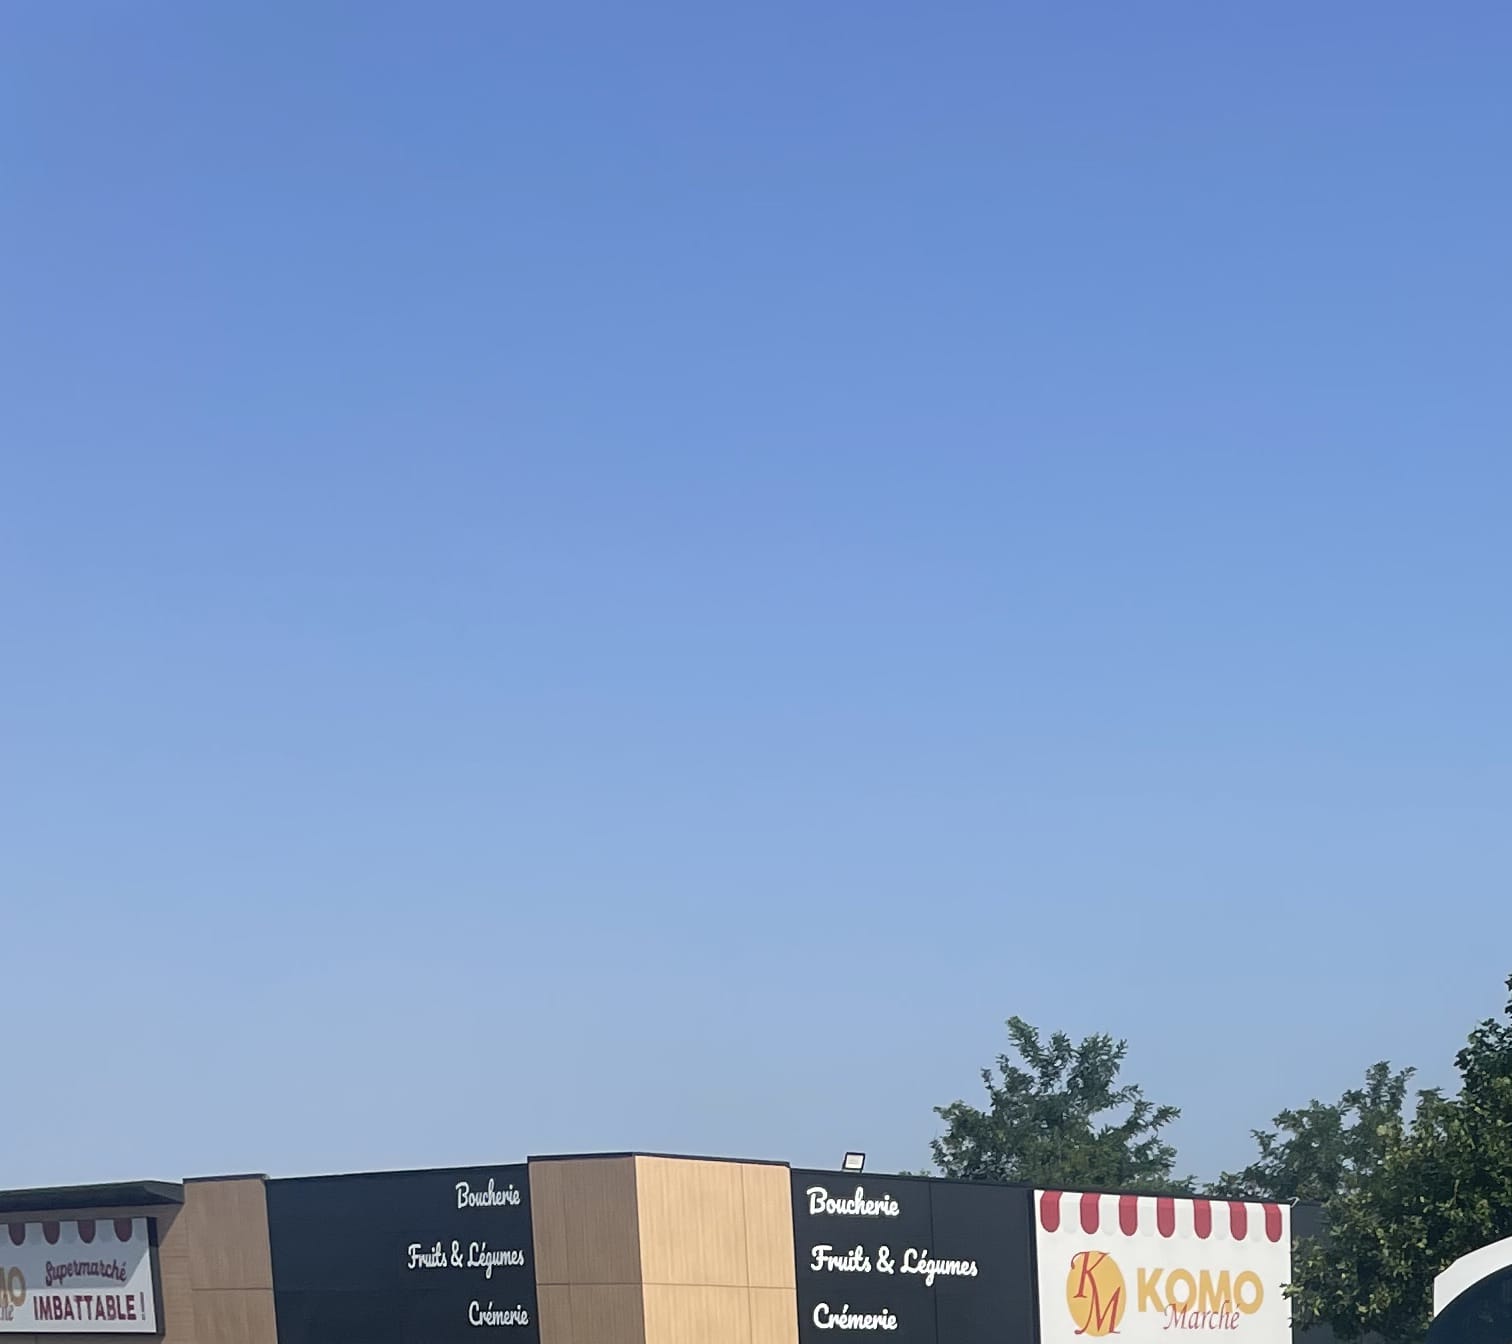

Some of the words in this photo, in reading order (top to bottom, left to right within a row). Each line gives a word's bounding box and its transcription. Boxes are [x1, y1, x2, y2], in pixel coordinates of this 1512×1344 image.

[455, 1178, 521, 1208] Boucherie
[806, 1186, 900, 1216] Boucherie
[45, 1258, 127, 1287] Supermarché
[408, 1241, 447, 1269] Fruits
[451, 1240, 463, 1268] &
[467, 1242, 525, 1279] Légumes
[811, 1244, 872, 1272] Fruits
[876, 1245, 895, 1275] &
[900, 1248, 978, 1287] Légumes
[1136, 1267, 1264, 1315] KOMO
[33, 1294, 137, 1321] IMBATTABLE
[468, 1301, 529, 1326] Crémerie
[813, 1302, 898, 1330] Crémerie
[1163, 1299, 1241, 1330] Marché
